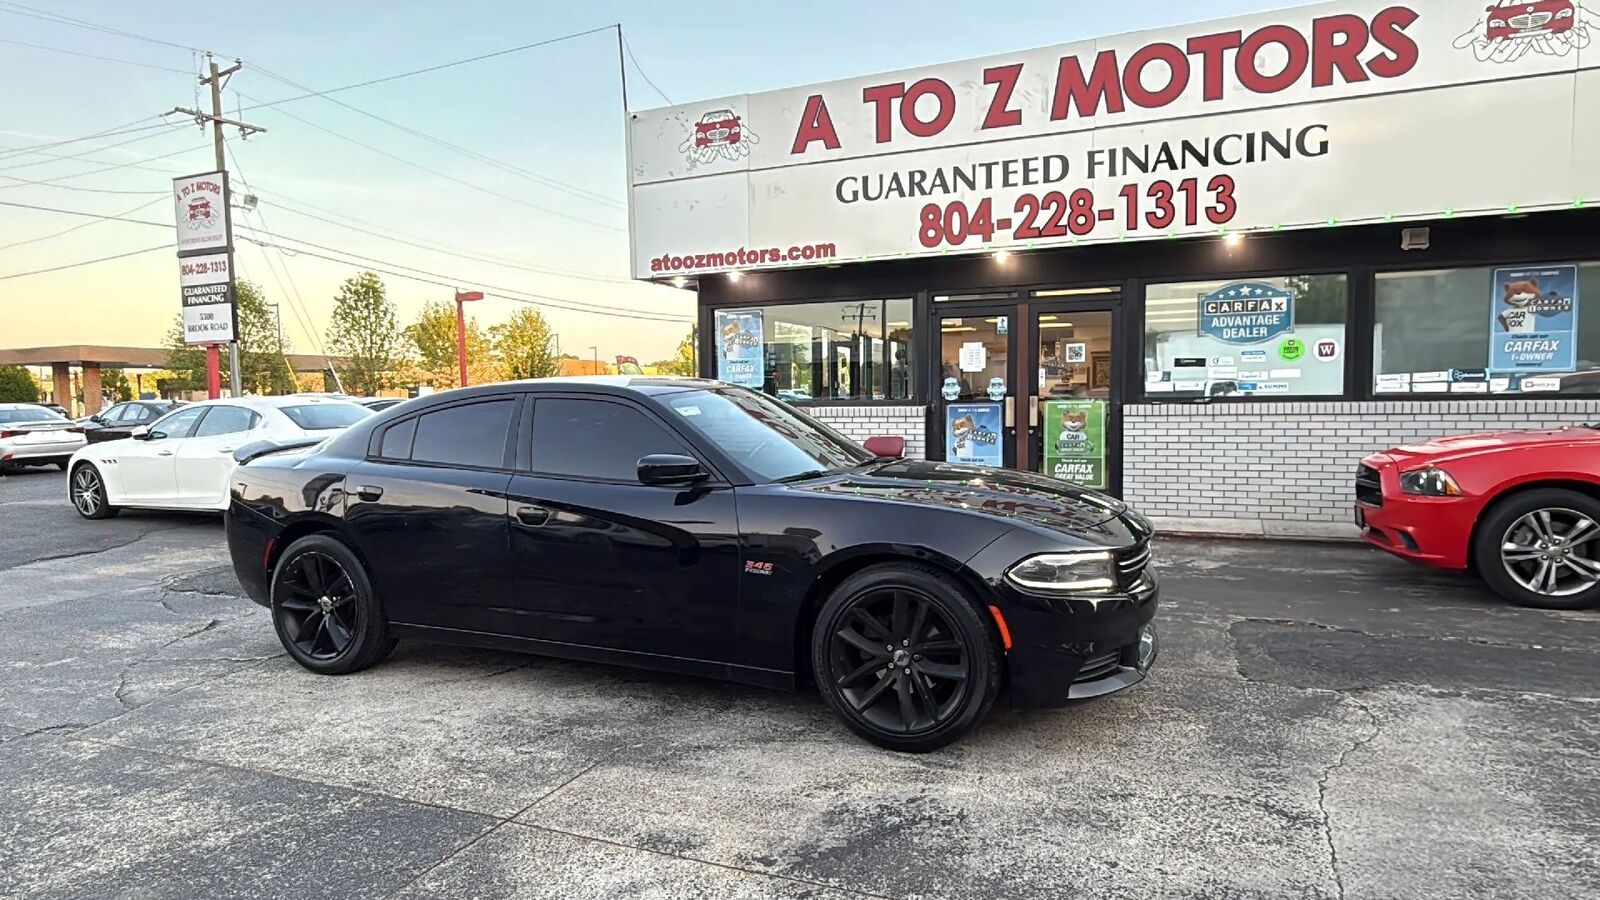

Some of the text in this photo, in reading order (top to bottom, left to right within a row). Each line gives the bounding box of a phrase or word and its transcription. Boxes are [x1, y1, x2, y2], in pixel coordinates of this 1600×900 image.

[790, 5, 1420, 155] A TO Z MOTORS
[836, 124, 1329, 204] GUARANTEED FINANCING
[181, 186, 191, 198] TO
[190, 183, 196, 195] Z
[196, 181, 221, 196] MOTORS
[918, 174, 1237, 248] 804-228-1313
[650, 239, 836, 273] atoozmotors.com
[181, 261, 227, 276] 804-228-1313
[184, 284, 227, 296] GUARANTEED
[187, 293, 224, 305] FINANCING
[1206, 299, 1286, 313] CARFAX
[187, 320, 228, 333] BROOK ROAD
[1211, 315, 1281, 328] ADVANTAGE
[1222, 327, 1268, 339] DEALER
[1320, 344, 1333, 356] W
[1504, 340, 1560, 352] CARFAX
[1511, 352, 1554, 361] 1-OWNER
[726, 364, 755, 373] CARFAX
[1066, 433, 1080, 441] CAR
[1054, 463, 1094, 474] CARFAX
[1074, 473, 1094, 481] VALUE
